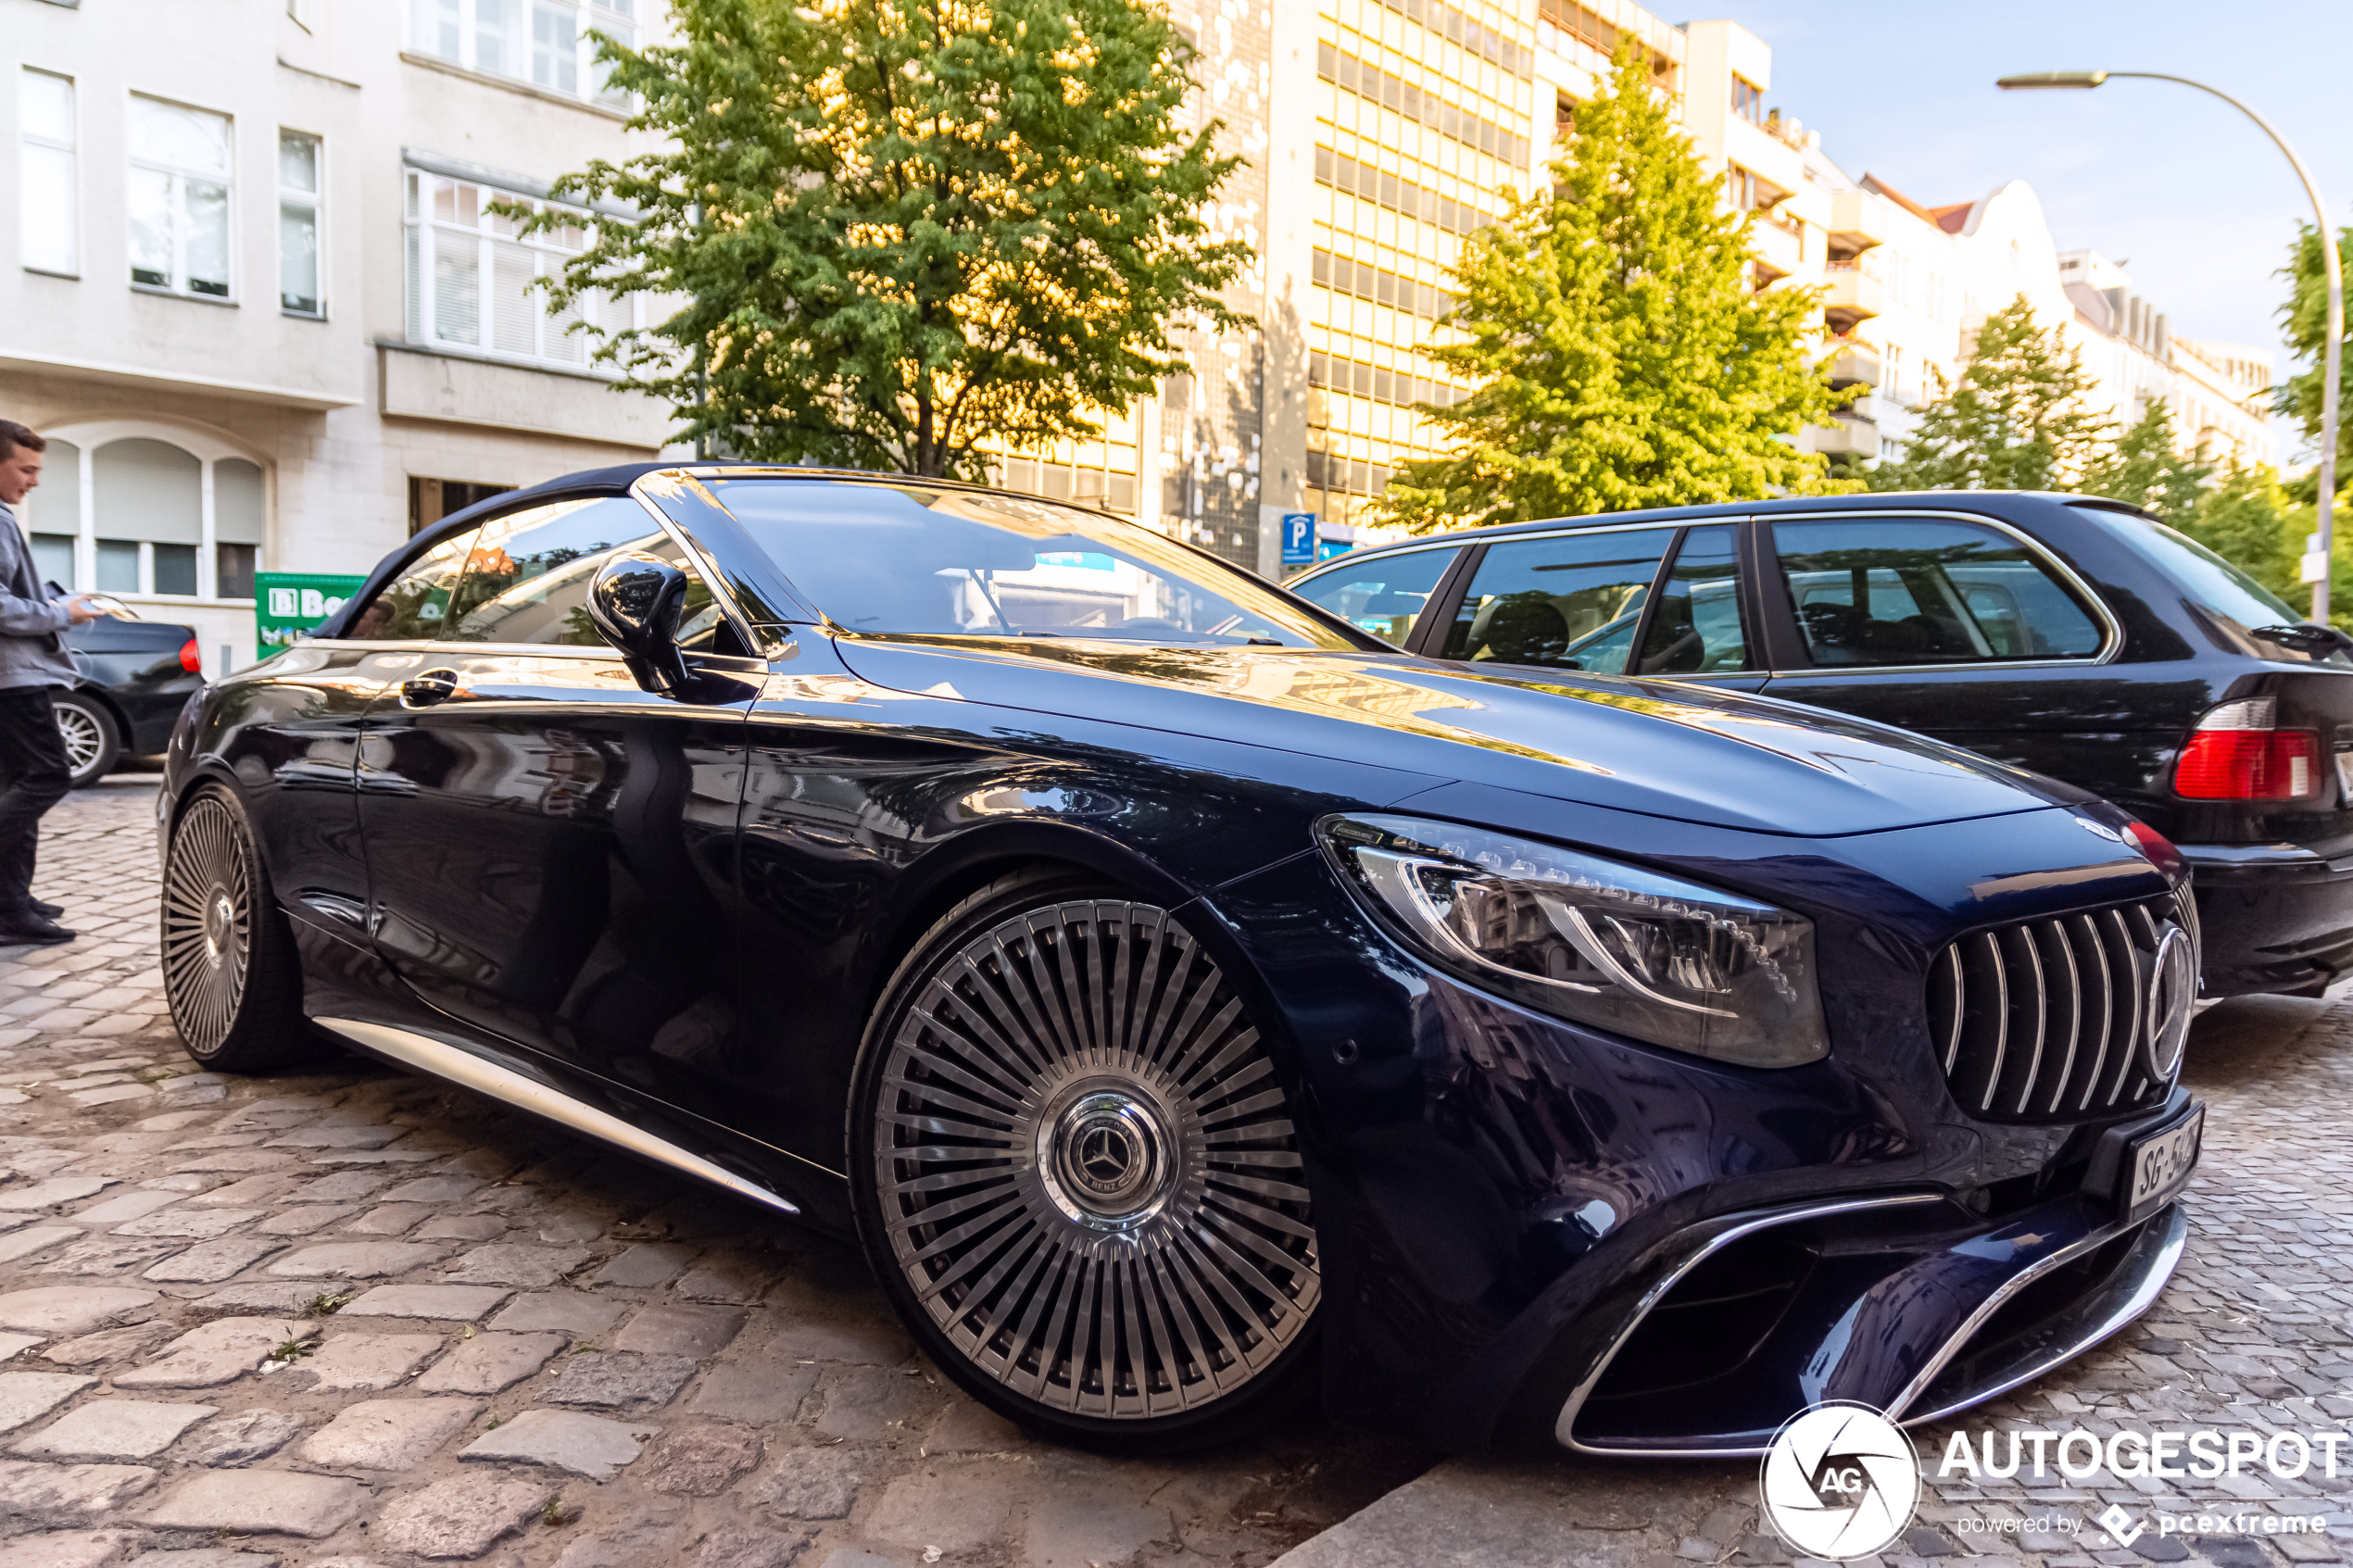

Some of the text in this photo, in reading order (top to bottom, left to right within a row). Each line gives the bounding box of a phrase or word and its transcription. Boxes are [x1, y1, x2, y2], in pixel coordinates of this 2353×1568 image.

[1292, 521, 1306, 547] P
[1084, 1120, 1130, 1137] MERCEDES
[1091, 1180, 1115, 1190] BENZ
